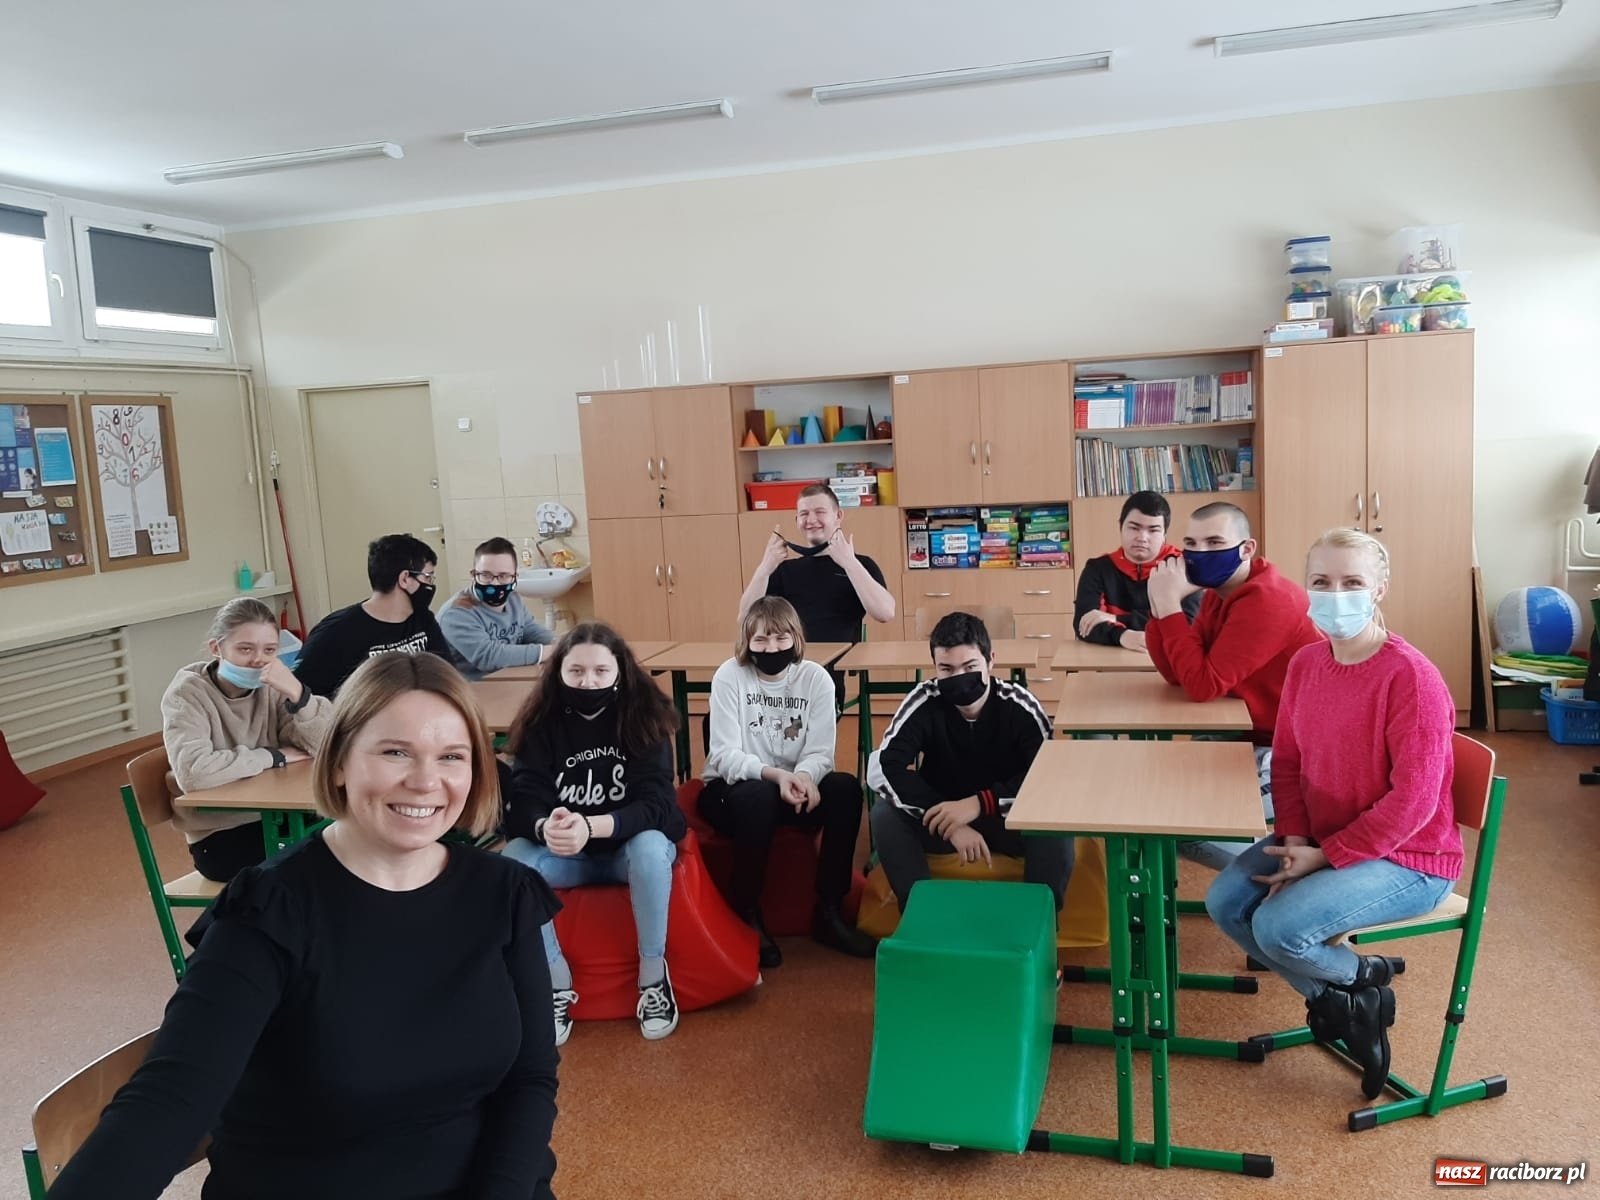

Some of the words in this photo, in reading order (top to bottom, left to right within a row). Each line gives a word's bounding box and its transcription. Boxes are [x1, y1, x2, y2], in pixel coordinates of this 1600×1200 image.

[112, 408, 120, 425] 8
[763, 695, 784, 709] YOUR
[566, 746, 627, 767] ORIGINAL
